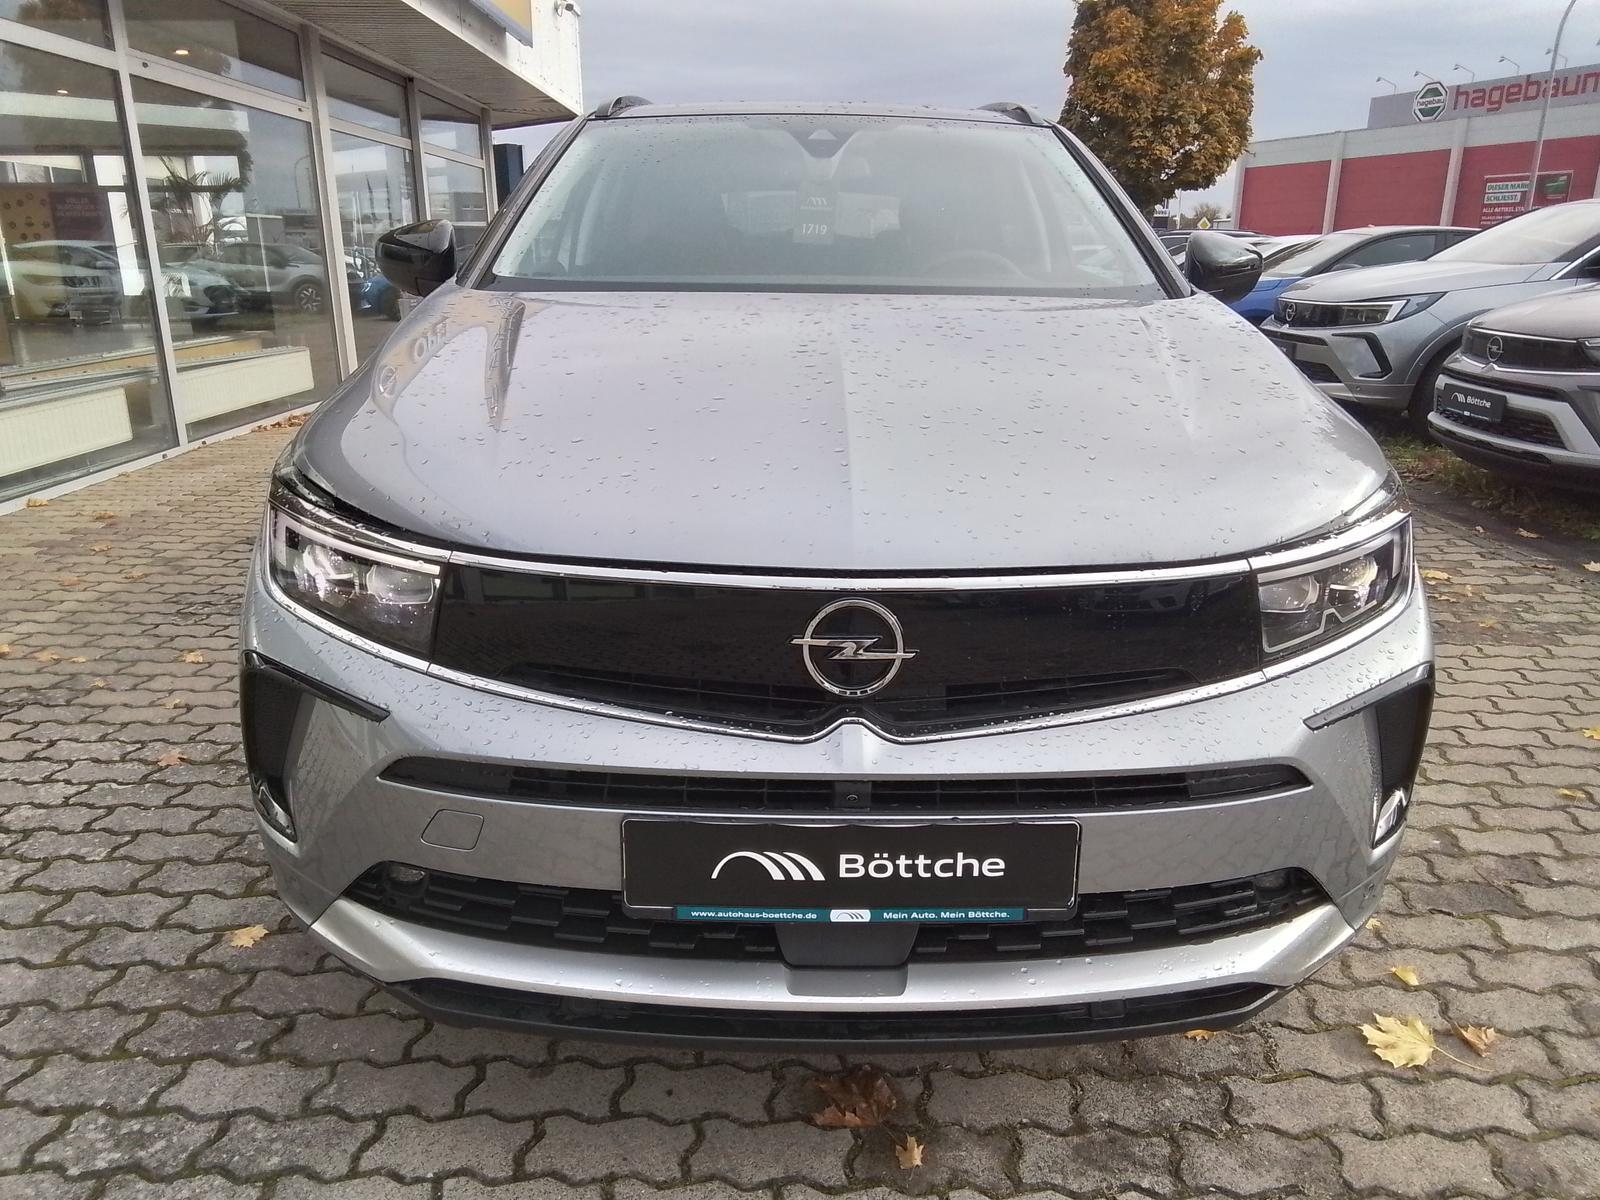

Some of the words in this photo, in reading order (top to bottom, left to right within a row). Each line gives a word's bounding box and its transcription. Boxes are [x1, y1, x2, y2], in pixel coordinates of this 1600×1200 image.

[1417, 98, 1445, 107] hagebau
[1510, 183, 1530, 191] MARK
[801, 223, 828, 235] 1719
[1466, 396, 1492, 408] Böttche
[838, 851, 1006, 879] Böttche
[690, 910, 818, 919] www.autohaus-boettche.de
[883, 911, 908, 919] Mein
[910, 911, 938, 919] Auto.
[940, 911, 966, 919] Mein
[968, 910, 1010, 918] Böttche.
